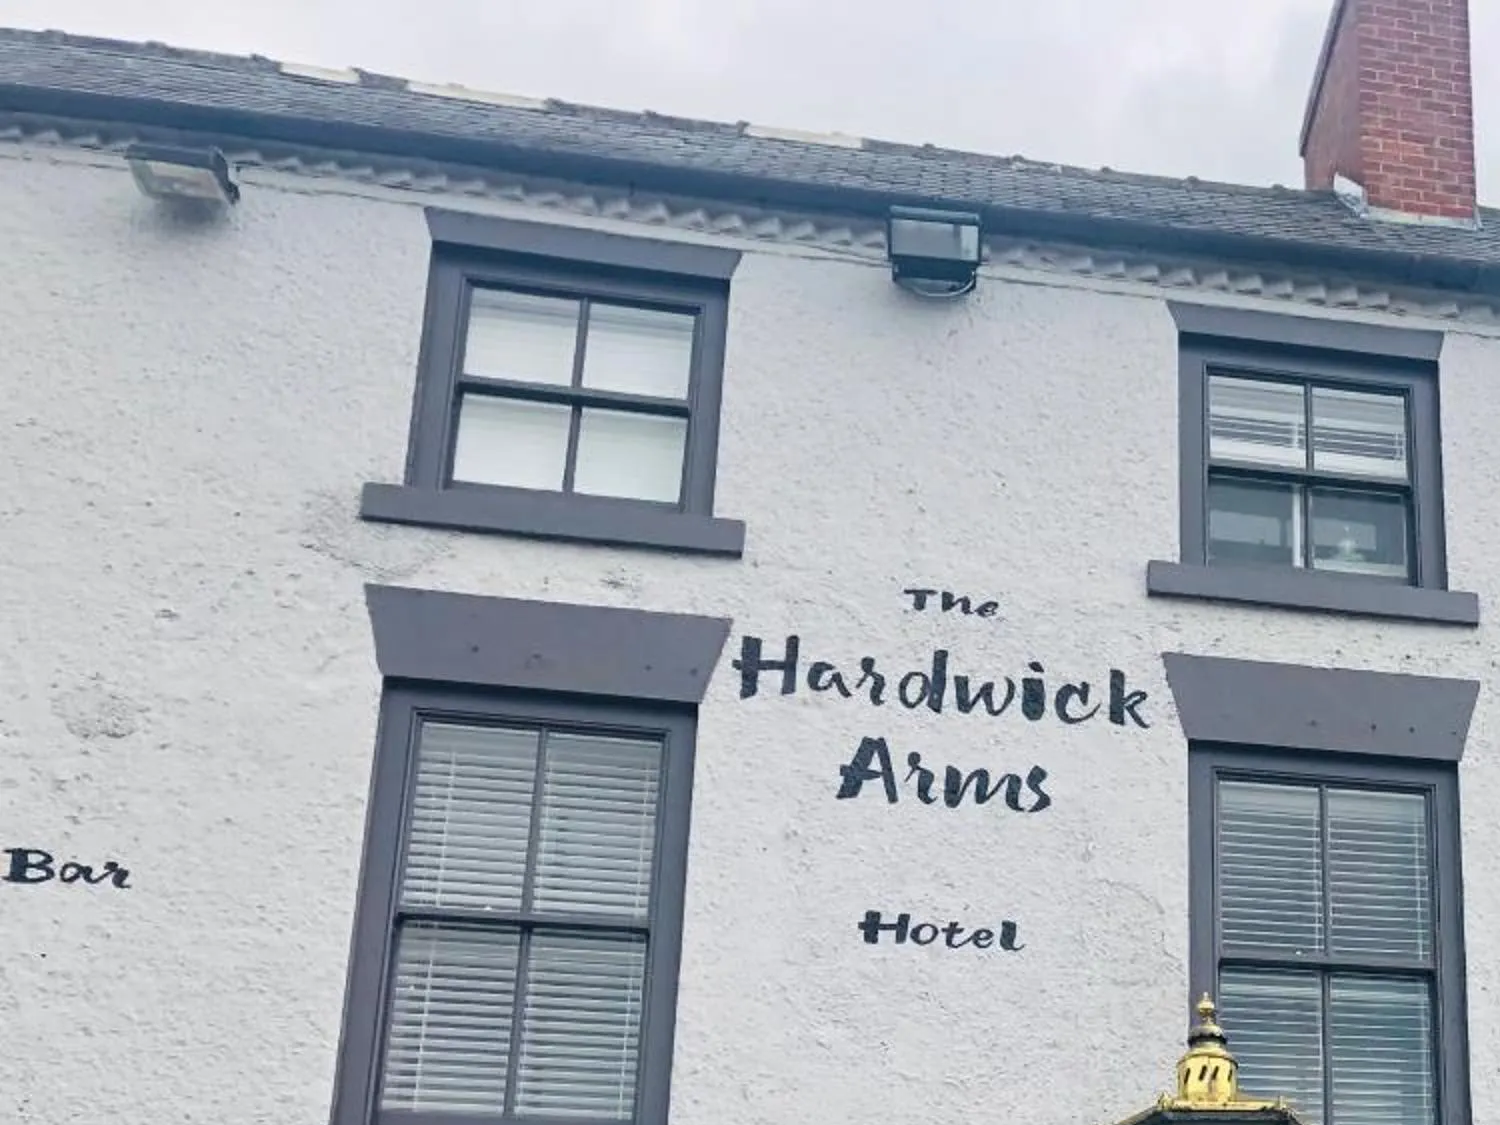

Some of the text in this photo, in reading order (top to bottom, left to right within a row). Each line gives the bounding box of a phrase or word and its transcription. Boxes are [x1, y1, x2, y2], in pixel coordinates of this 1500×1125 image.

[903, 588, 1001, 619] The
[732, 634, 1150, 729] Hardwick
[835, 736, 1052, 813] Arms
[1, 847, 132, 889] Bar
[857, 909, 1027, 952] Hotel
